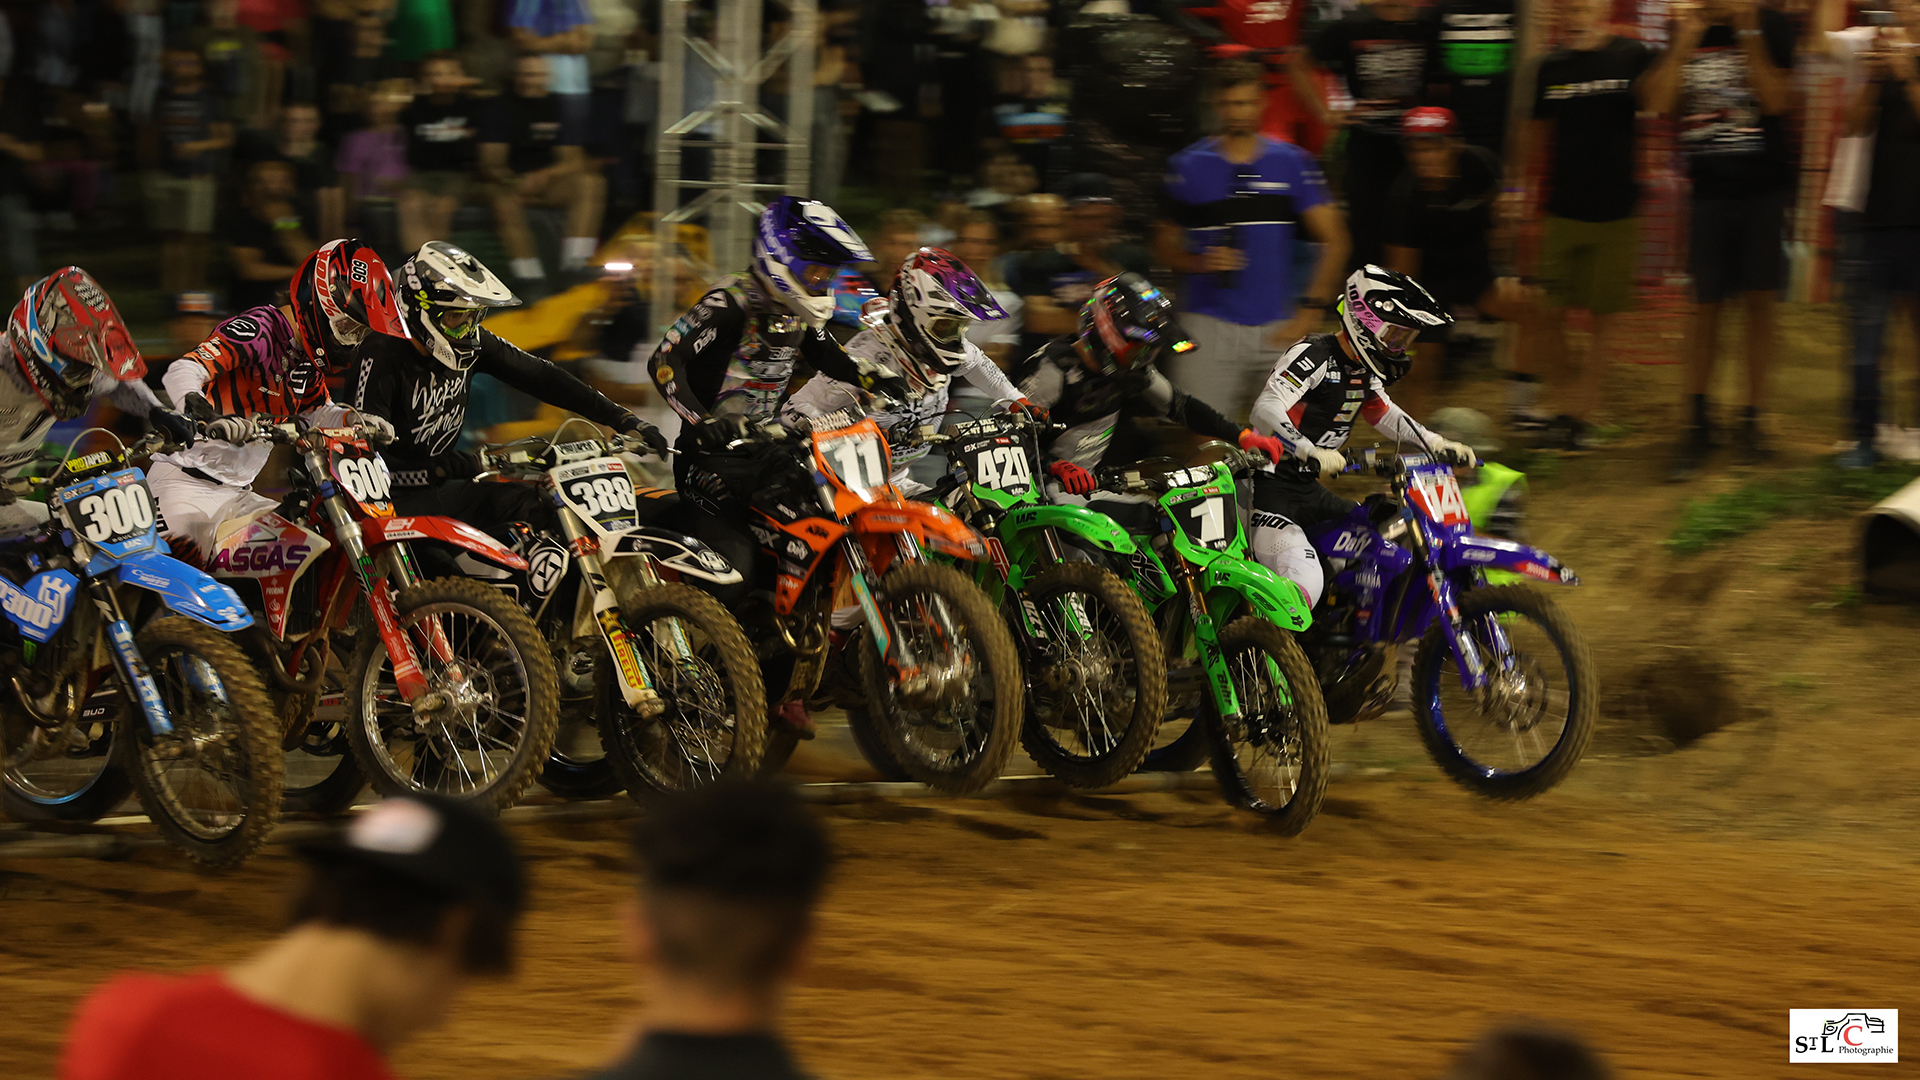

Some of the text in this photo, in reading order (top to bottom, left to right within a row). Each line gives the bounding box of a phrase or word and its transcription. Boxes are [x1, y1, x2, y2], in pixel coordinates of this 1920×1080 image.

[323, 428, 355, 438] SCAR
[978, 446, 1031, 491] 420
[79, 483, 153, 542] 300
[570, 476, 635, 517] 388
[1190, 496, 1225, 543] 1
[1251, 512, 1294, 530] SHOT
[205, 544, 312, 573] ASGAS
[1333, 530, 1372, 558] Dafy
[1355, 572, 1381, 590] YAMAHA
[383, 586, 423, 676] DULOP
[612, 632, 643, 688] PIRELLI
